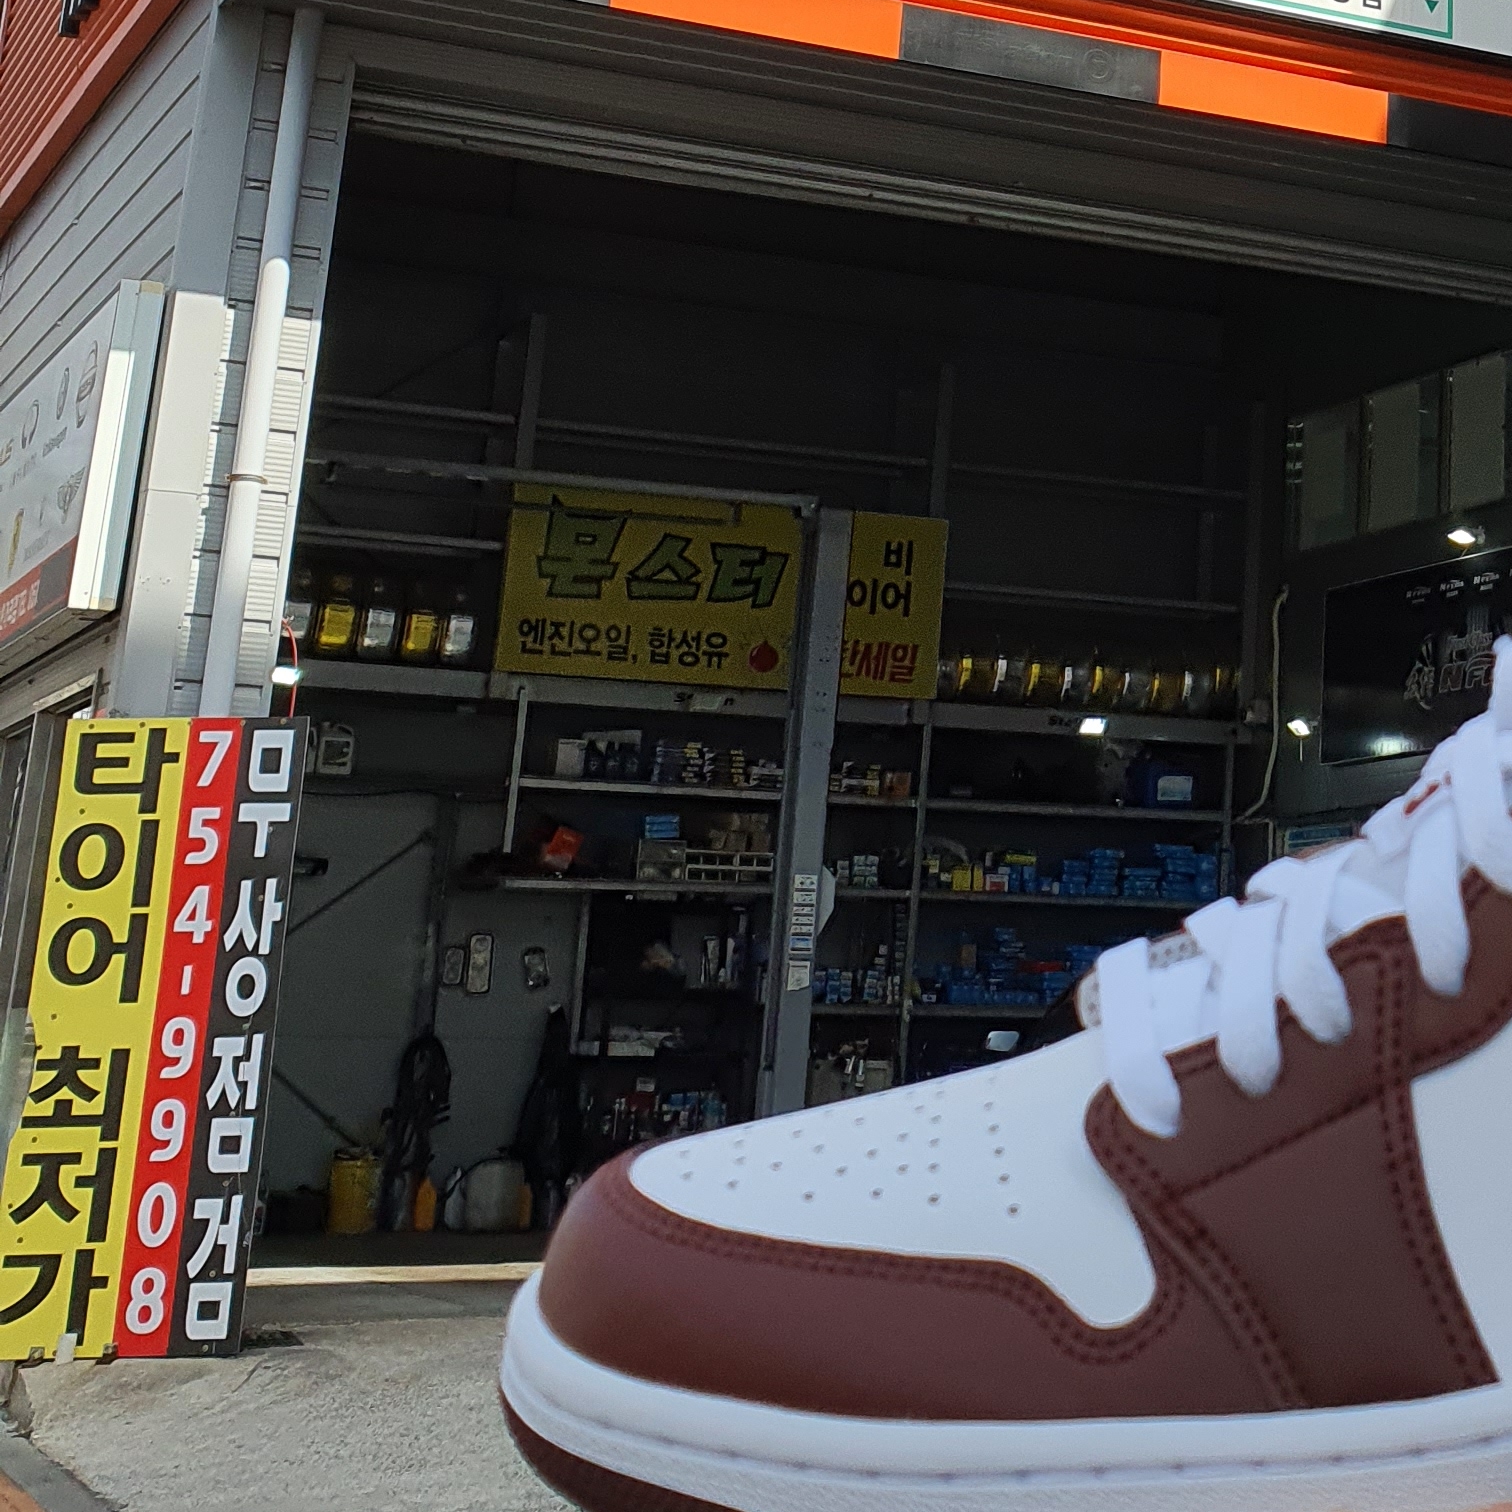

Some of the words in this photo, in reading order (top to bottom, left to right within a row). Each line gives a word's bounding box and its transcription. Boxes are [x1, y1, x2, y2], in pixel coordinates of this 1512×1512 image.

[517, 616, 638, 663] 엔진오일,
[648, 627, 730, 670] 합성유
[538, 495, 789, 608] 몬스터
[48, 727, 180, 1004] 타이어
[125, 730, 232, 1336] 754-9908
[185, 729, 297, 1341] 무상점검
[0, 1045, 131, 1348] 최저가
